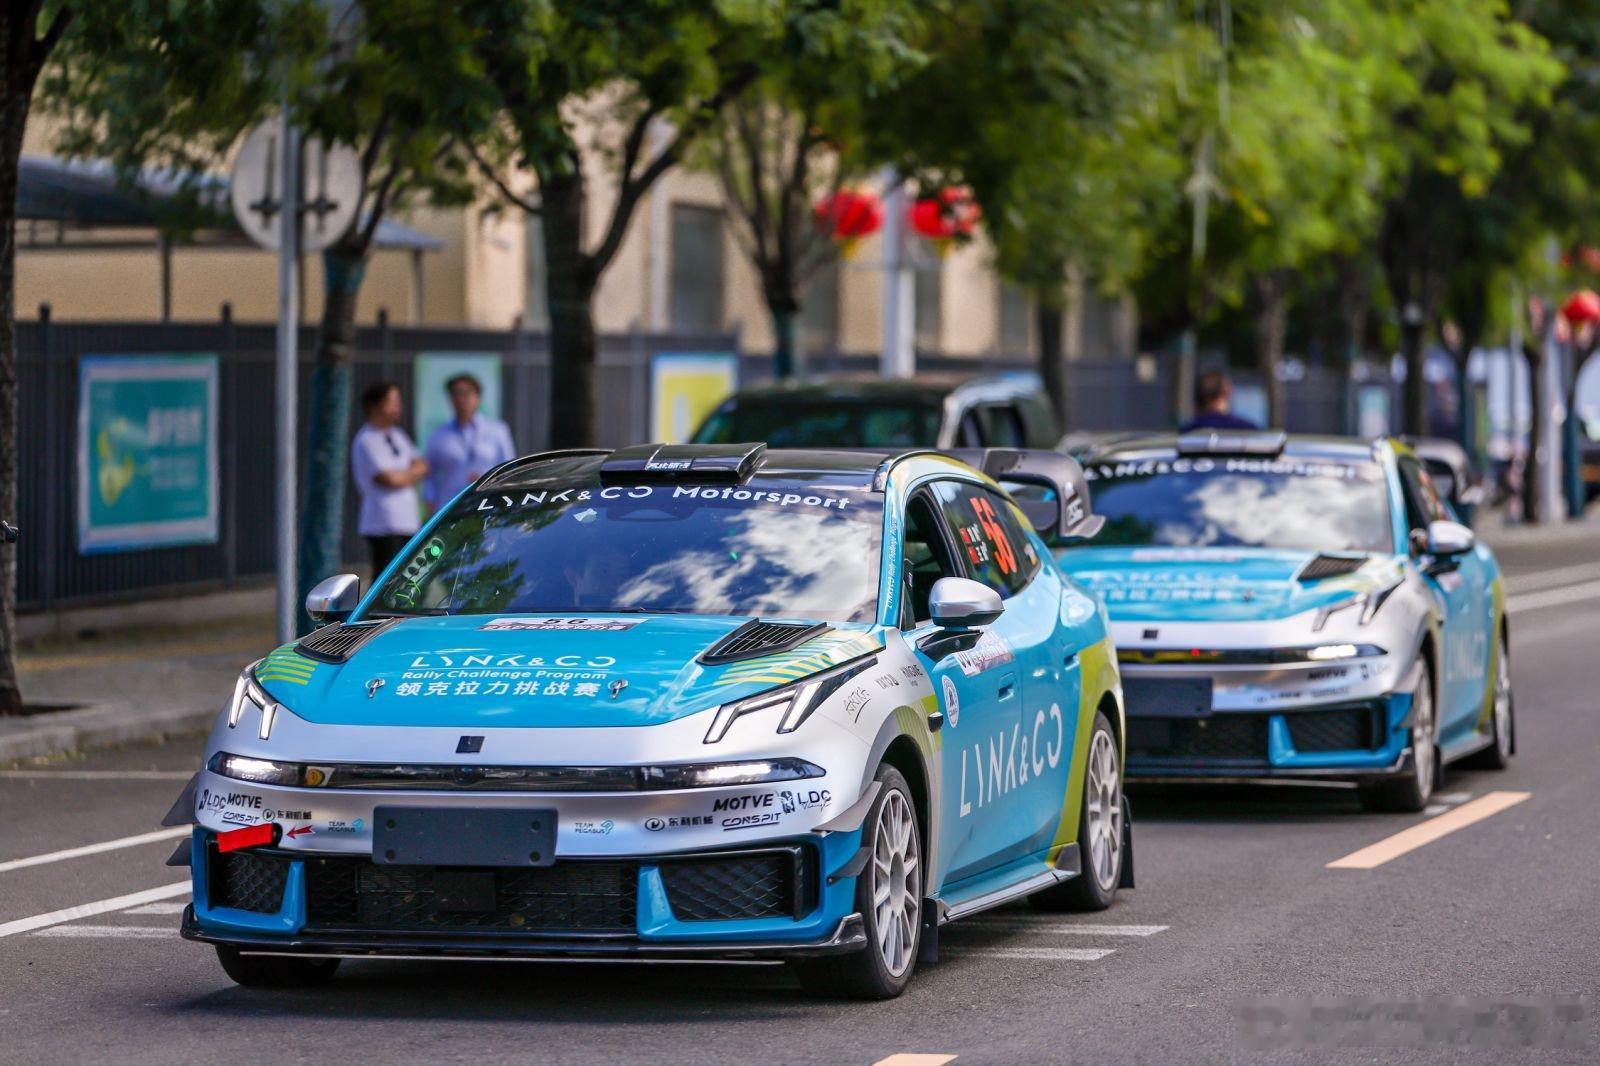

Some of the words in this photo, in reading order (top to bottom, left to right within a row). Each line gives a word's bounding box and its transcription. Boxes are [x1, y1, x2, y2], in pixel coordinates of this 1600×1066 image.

[477, 486, 653, 511] LYNK&CO
[672, 486, 850, 510] Motorsport
[410, 655, 617, 668] LYNK&CO
[402, 671, 444, 680] Rally
[447, 670, 531, 679] Challenge
[535, 670, 607, 680] Program
[396, 681, 602, 697] 领克拉力挑战赛
[959, 702, 1063, 818] LYNK&CO
[207, 793, 226, 809] LDC
[227, 793, 262, 809] MOTVE
[713, 793, 774, 812] MOTVE
[797, 789, 832, 805] LDC
[721, 812, 782, 828] CONSPIT
